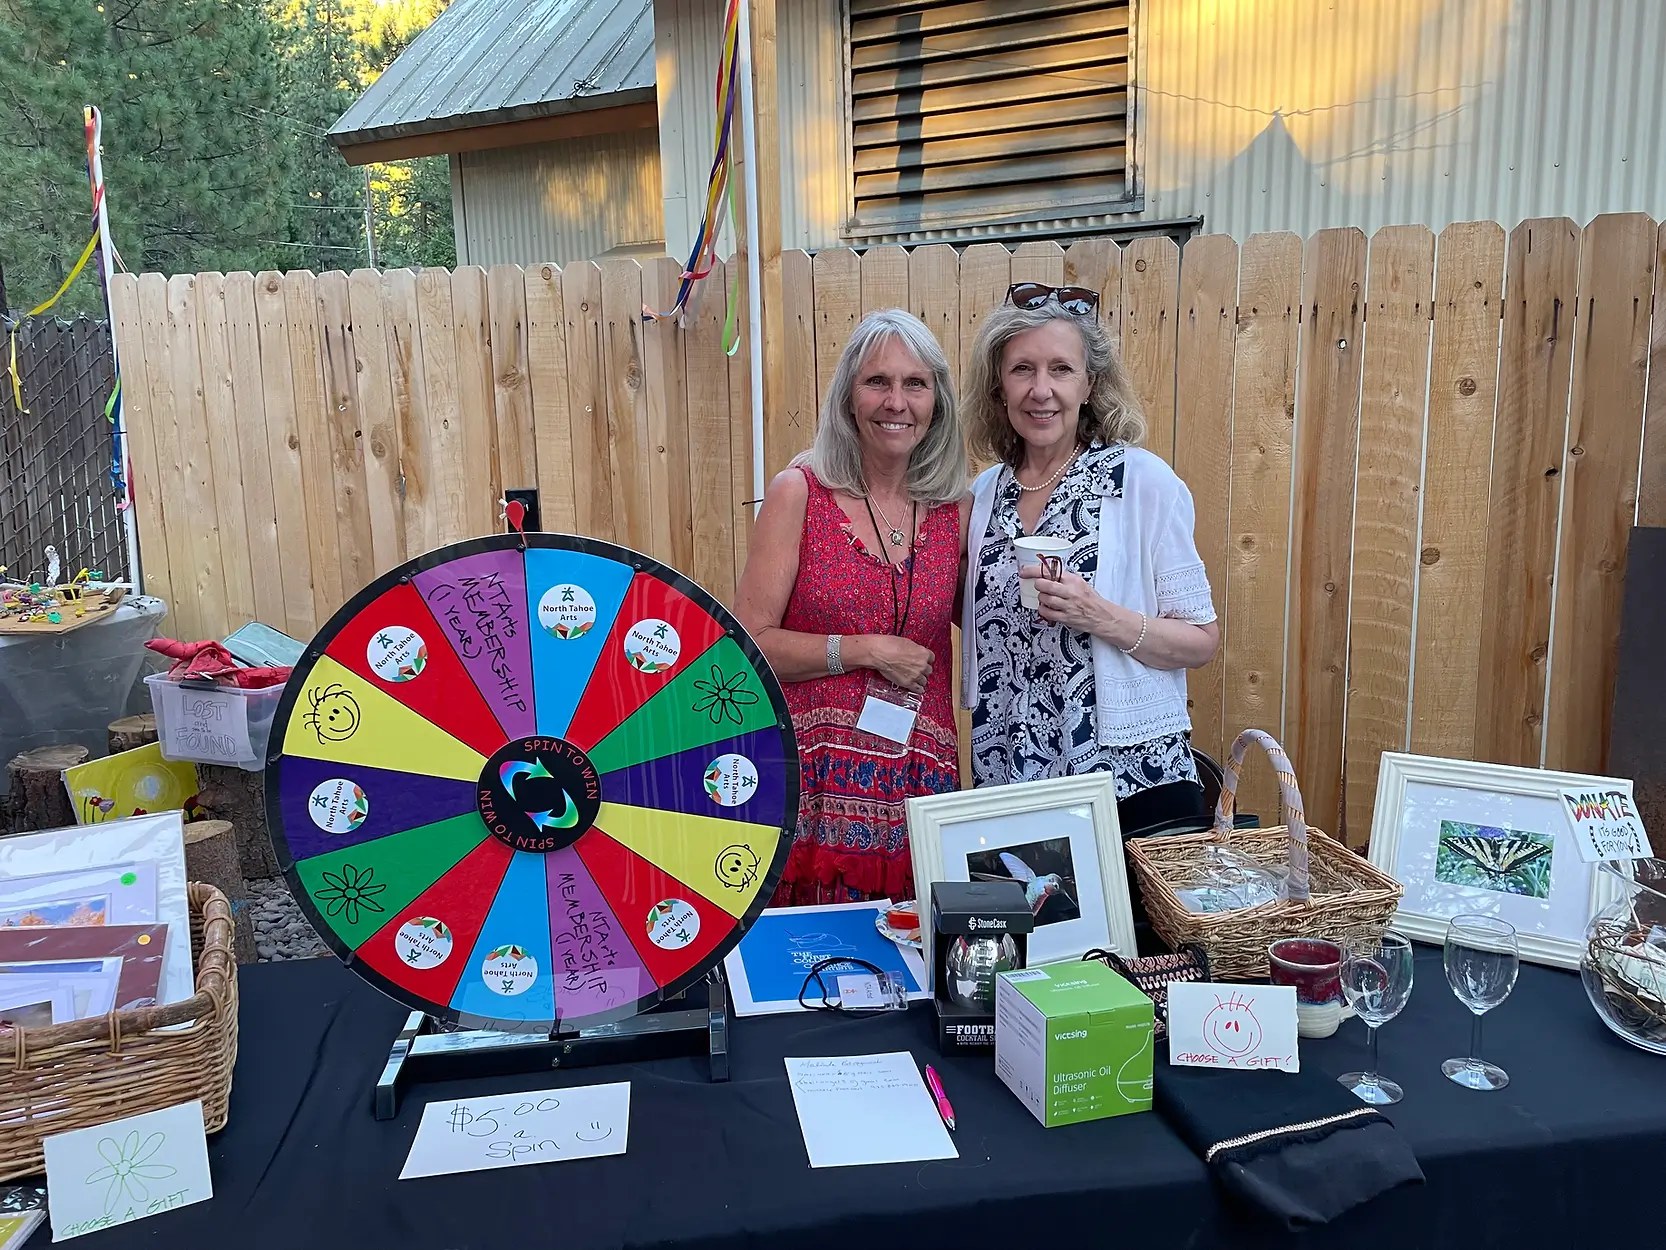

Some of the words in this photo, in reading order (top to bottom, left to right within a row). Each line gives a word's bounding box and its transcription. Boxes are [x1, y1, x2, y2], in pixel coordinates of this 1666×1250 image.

[569, 604, 594, 612] Tahoe
[444, 605, 482, 659] YEAR)
[375, 650, 396, 670] North
[393, 632, 415, 652] Tahoe
[458, 577, 527, 713] MEMBERSHIP
[632, 630, 654, 645] North
[655, 640, 678, 656] Tahoe
[643, 645, 659, 657] Arts
[395, 650, 410, 665] Arts
[182, 695, 228, 721] LOST
[175, 727, 237, 757] FOUND
[524, 740, 563, 753] SPIN
[567, 747, 584, 765] TO
[581, 766, 598, 799] WIN
[732, 758, 740, 781] North
[331, 781, 344, 806] Tahoe
[731, 782, 739, 804] Tahoe
[339, 798, 349, 815] Arts
[480, 790, 497, 824] WIN
[1563, 790, 1636, 822] DONATE
[326, 807, 337, 828] North
[495, 824, 512, 843] TO
[1611, 825, 1628, 837] GOOD
[516, 836, 555, 849] SPIN
[1601, 840, 1616, 853] FOR
[661, 914, 675, 928] Arts
[674, 911, 694, 927] North
[400, 931, 421, 947] Tahoe
[419, 932, 434, 944] Arts
[557, 873, 607, 993] MEMBERSHIP
[655, 925, 676, 944] Tahoe
[422, 943, 443, 960] North
[561, 949, 586, 991] YEAR)
[957, 1025, 996, 1035] FOOTB
[1177, 1052, 1218, 1064] CHOOSE
[1228, 1057, 1238, 1066] A
[1053, 1068, 1096, 1083] Ultrasonic
[1099, 1065, 1111, 1076] Oil
[1053, 1083, 1087, 1095] Diffuser
[446, 1098, 560, 1137] $5.00
[60, 1214, 117, 1236] CHOOSE
[124, 1207, 136, 1221] A
[146, 1189, 189, 1214] GIFT
